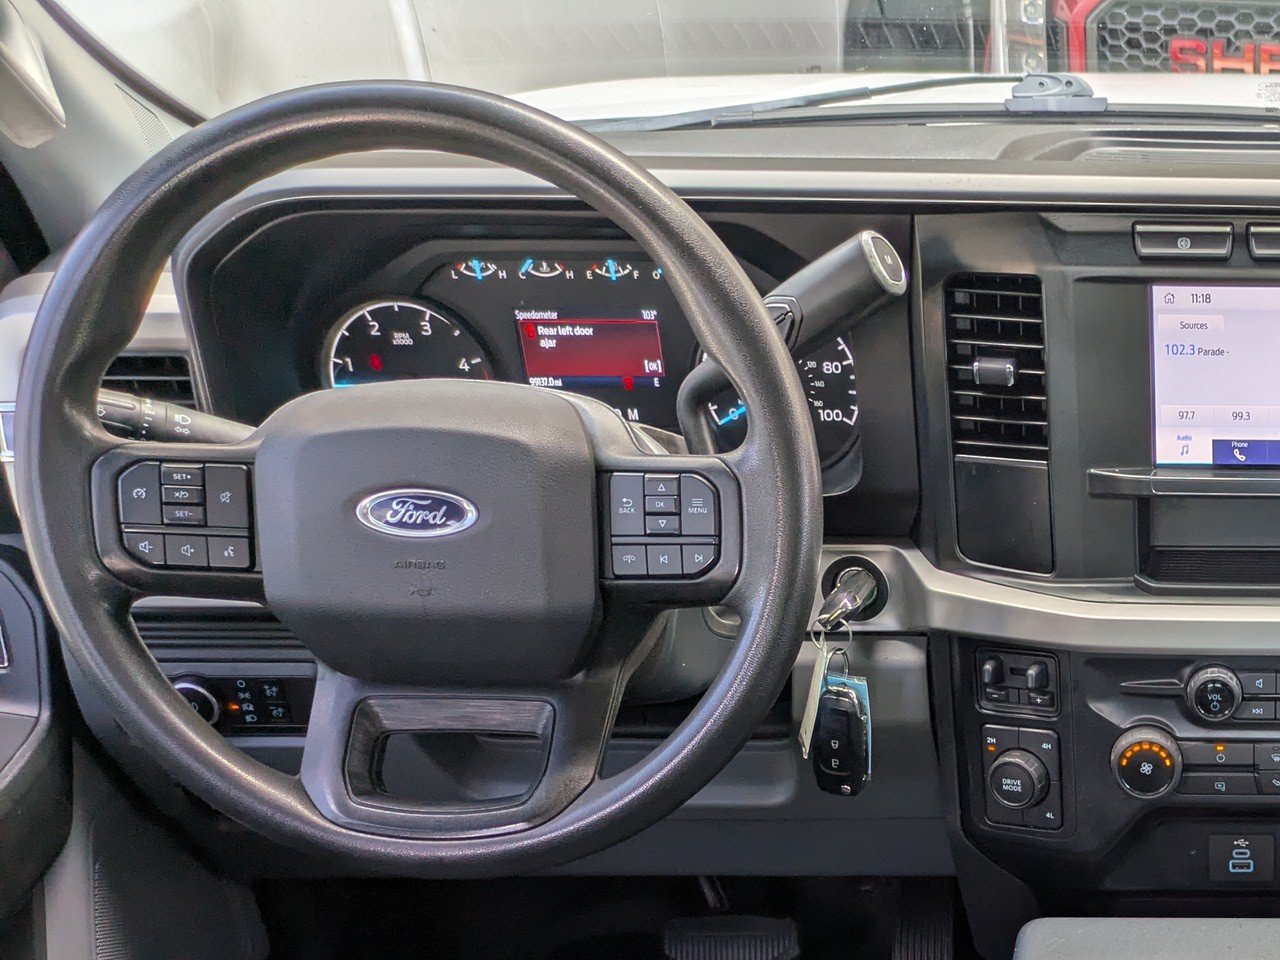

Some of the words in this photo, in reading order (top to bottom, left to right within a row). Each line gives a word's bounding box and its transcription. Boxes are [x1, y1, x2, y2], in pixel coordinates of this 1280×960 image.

[451, 270, 458, 279] L
[498, 270, 507, 279] H
[518, 271, 526, 280] C
[565, 270, 574, 279] H
[586, 270, 593, 280] E
[633, 270, 639, 280] F
[1190, 293, 1212, 304] 11:18
[515, 310, 558, 320] Speedometer
[369, 322, 380, 335] 2
[420, 322, 432, 335] 3
[537, 325, 558, 336] Rear
[558, 325, 574, 336] left
[575, 325, 594, 336] door
[1179, 321, 1208, 330] Sources
[540, 338, 557, 349] ajar
[1165, 344, 1196, 356] 102.3
[1197, 347, 1225, 356] Parade
[345, 358, 353, 371] 1
[458, 358, 470, 371] 4
[823, 362, 841, 373] 80
[653, 377, 660, 387] E
[814, 380, 825, 388] 140
[627, 408, 639, 421] M
[818, 409, 843, 421] 100
[1178, 410, 1195, 420] 97.7
[1231, 411, 1251, 421] 99.3
[386, 498, 447, 524] Ford
[393, 560, 446, 570] AIRBAG
